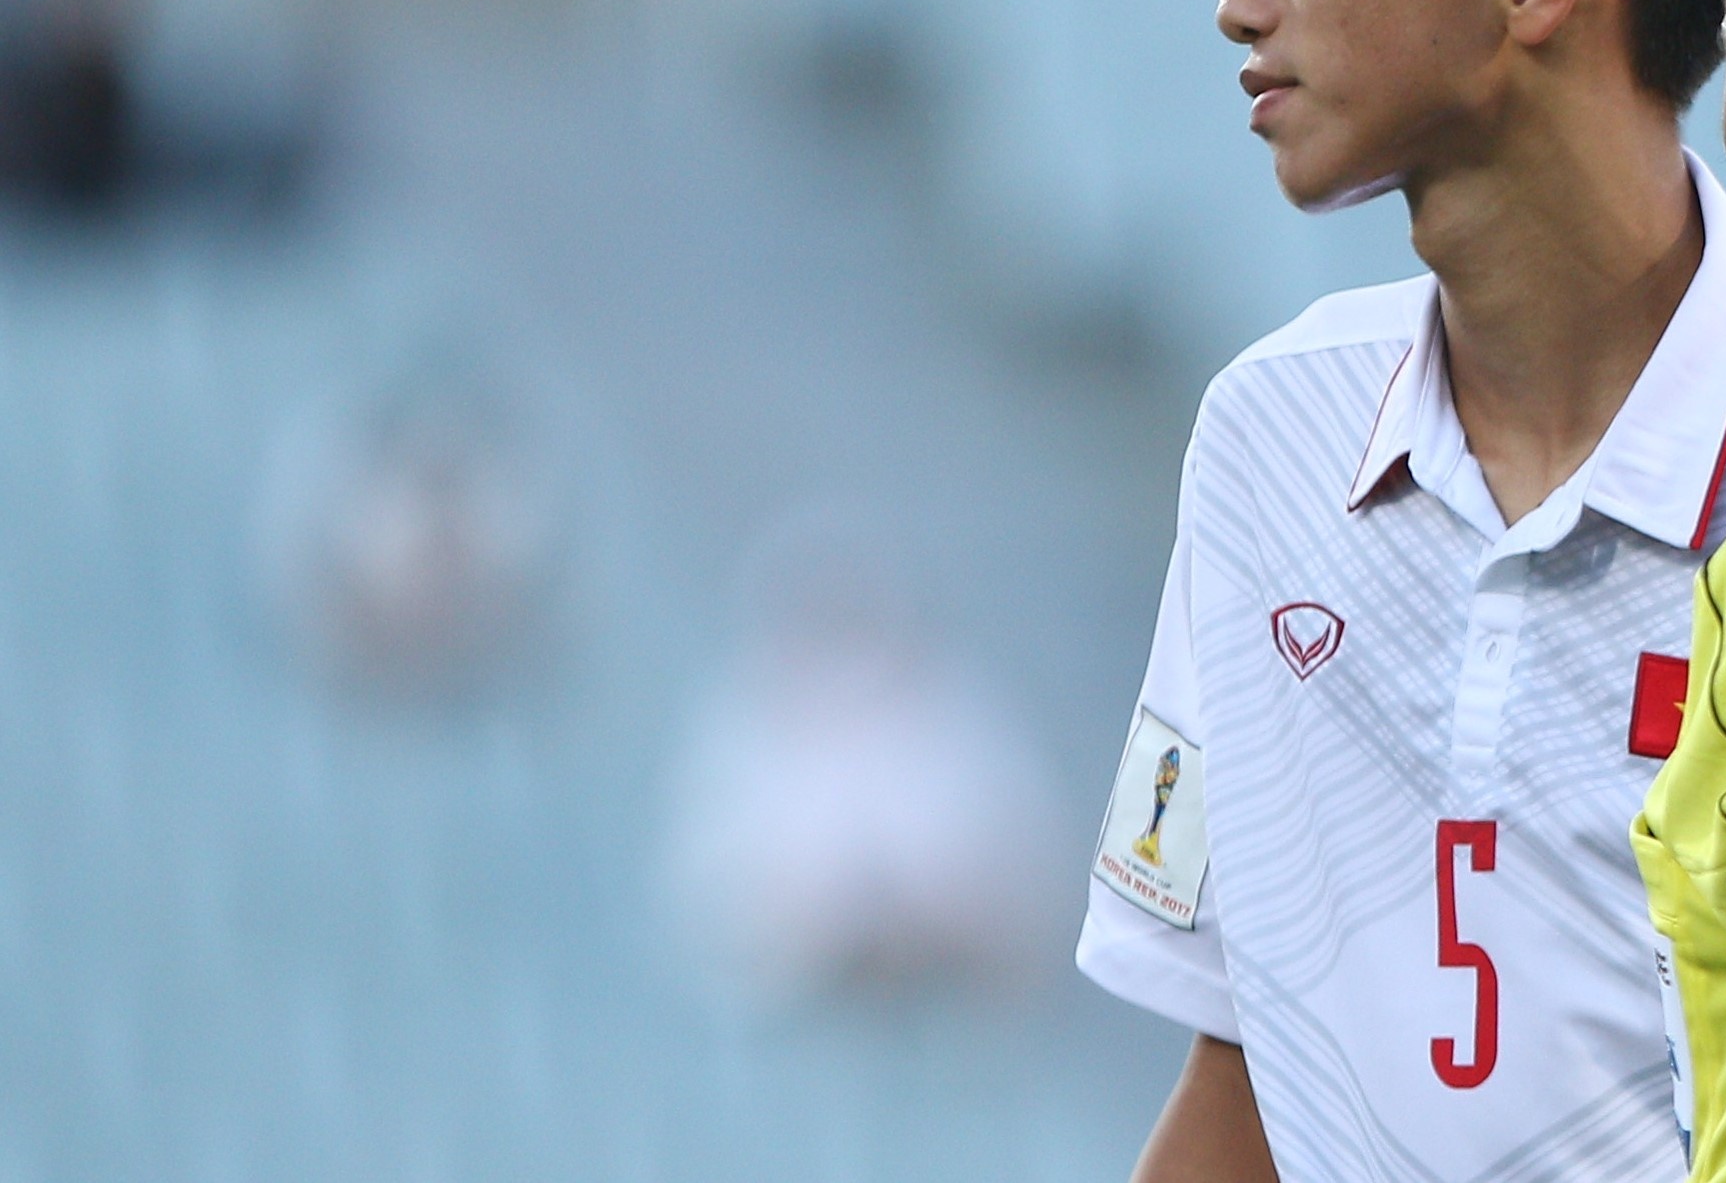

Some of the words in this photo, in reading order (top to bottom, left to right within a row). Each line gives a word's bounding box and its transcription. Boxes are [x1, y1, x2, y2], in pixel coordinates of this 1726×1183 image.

[1100, 852, 1132, 886] KOREA
[1159, 894, 1193, 918] 2017
[1429, 819, 1499, 1088] 5
